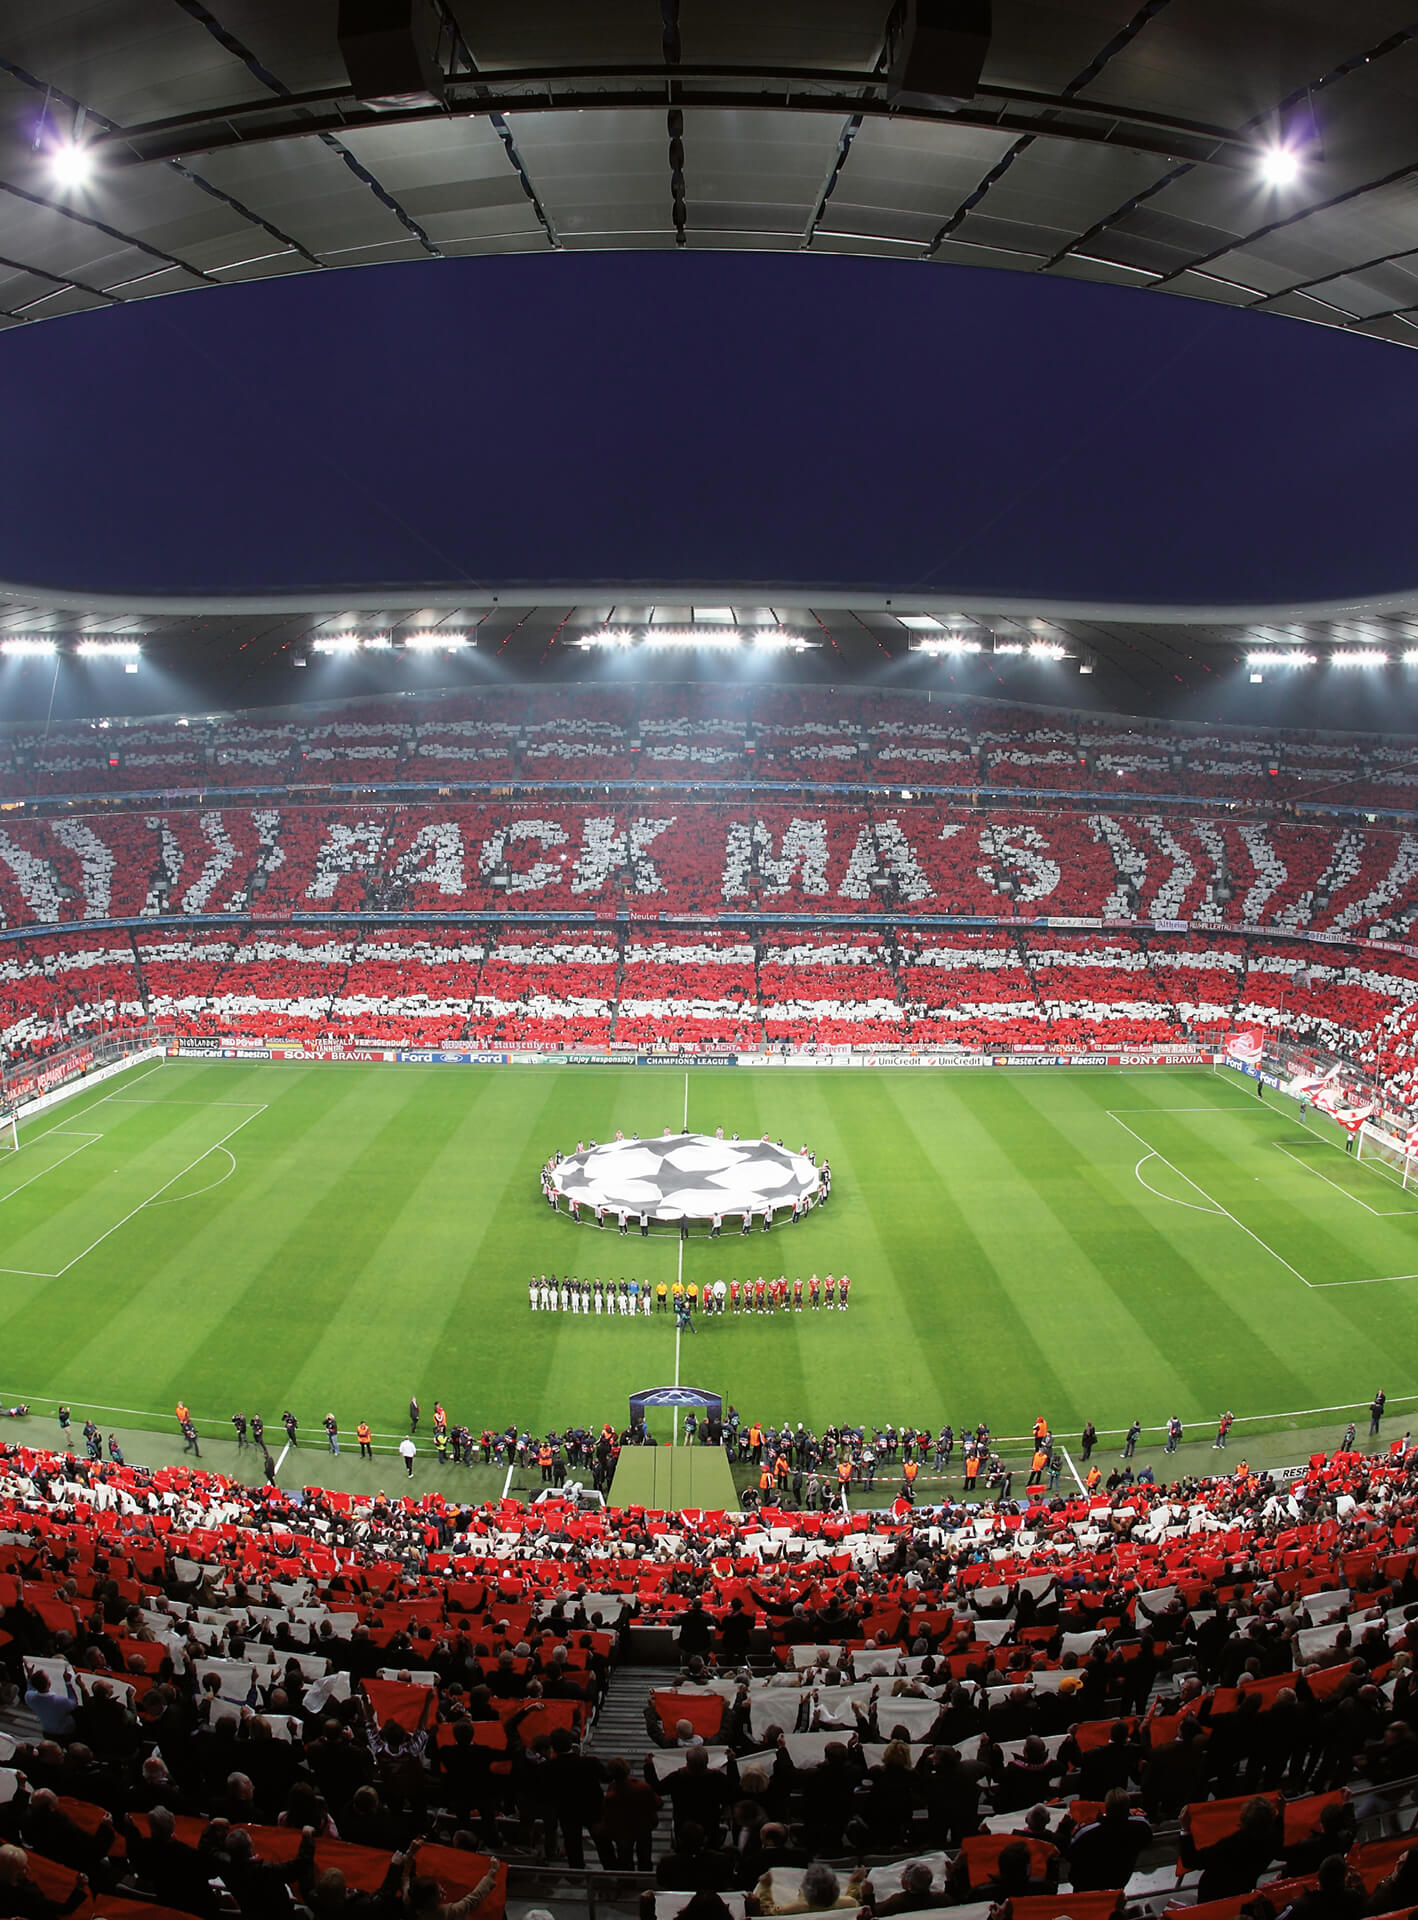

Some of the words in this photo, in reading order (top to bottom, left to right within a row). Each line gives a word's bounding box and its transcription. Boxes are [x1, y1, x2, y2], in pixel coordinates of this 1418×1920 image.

[630, 912, 658, 921] Neuler
[1157, 920, 1188, 931] Altheim
[221, 1038, 235, 1046] RED
[236, 1038, 264, 1047] POWER
[178, 1049, 223, 1057] MasterCard
[236, 1050, 269, 1059] Maestro
[284, 1051, 326, 1060] SONY
[331, 1052, 373, 1060] BRAVIA
[401, 1053, 432, 1062] Ford
[470, 1054, 502, 1063] Ford
[569, 1056, 590, 1065] Enjoy
[590, 1056, 635, 1065] Responsibly
[646, 1057, 695, 1065] CHAMPIONS
[697, 1057, 729, 1065] LEAGUE
[878, 1056, 921, 1066] UniCredit
[938, 1057, 981, 1066] UniCredit
[1007, 1056, 1056, 1065] MasterCard
[1070, 1056, 1105, 1065] Maestro
[1119, 1055, 1162, 1065] SONY
[1165, 1055, 1204, 1065] BRAVIA
[1226, 1056, 1243, 1072] Ford
[1259, 1071, 1278, 1088] Ford
[1282, 1467, 1309, 1479] RESP
